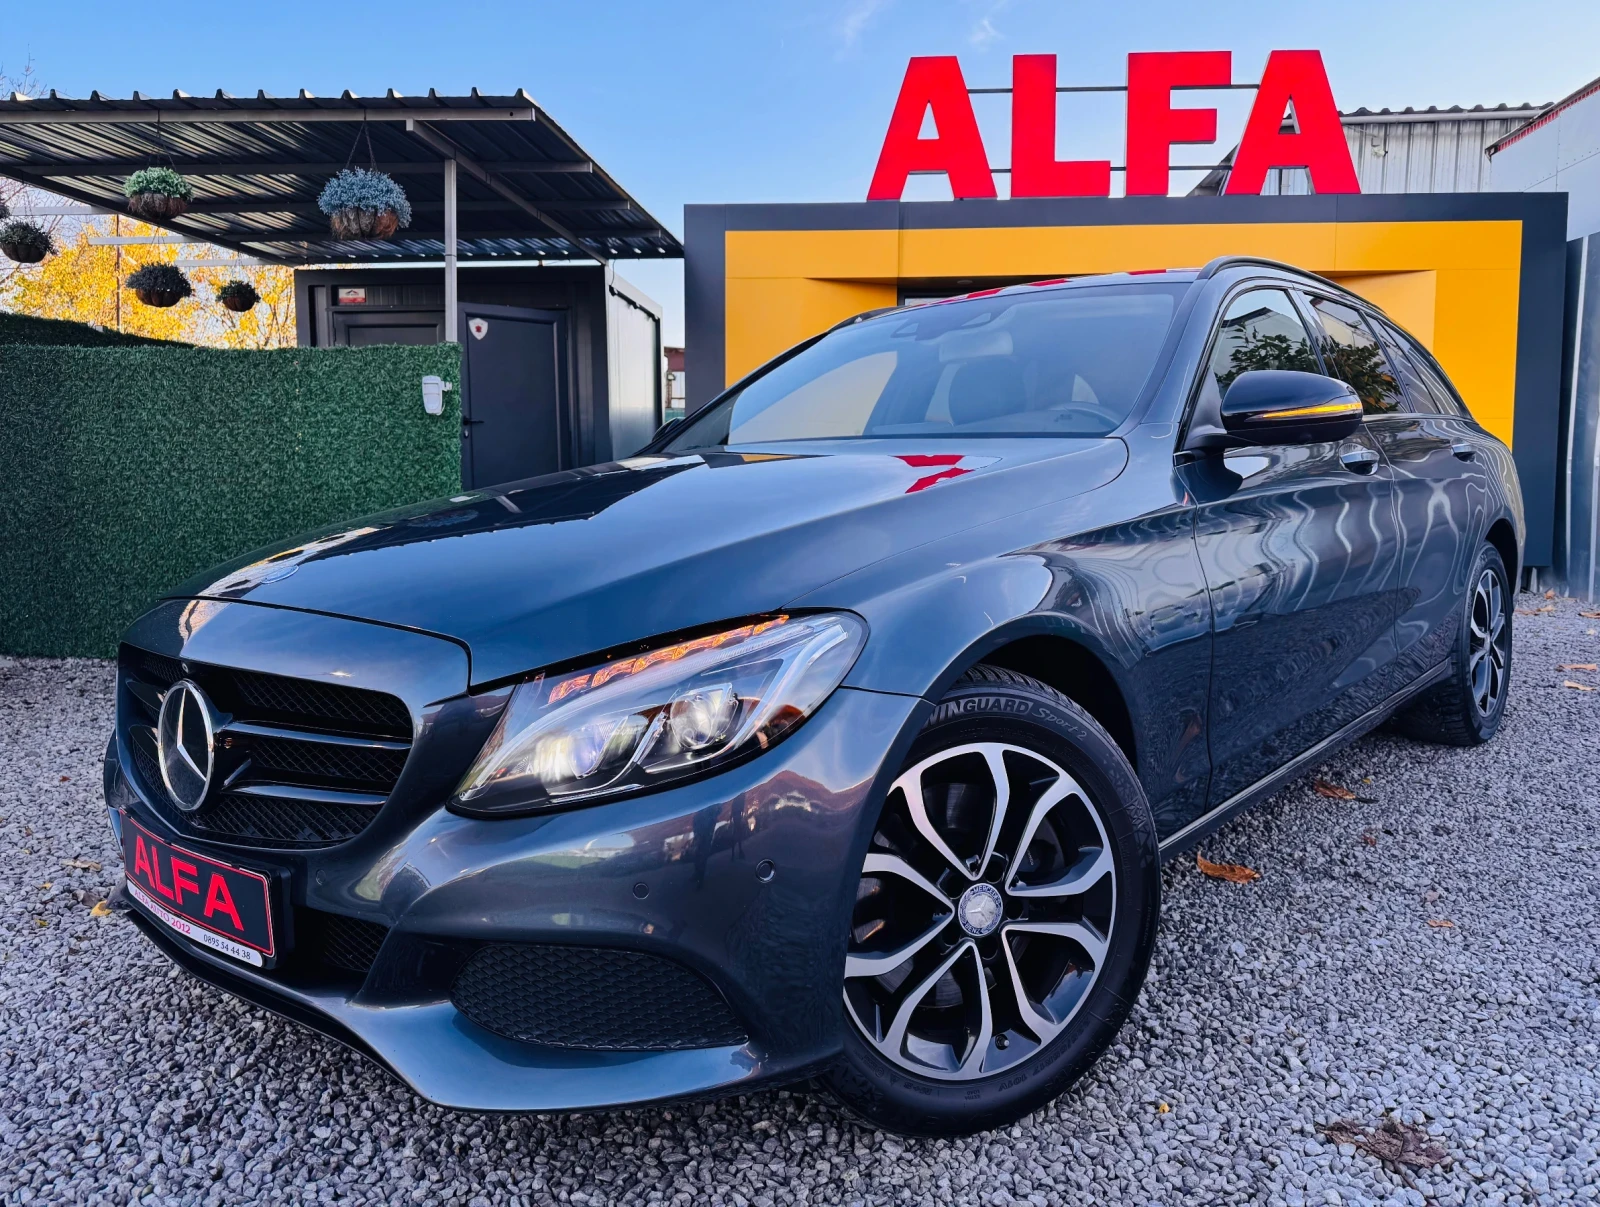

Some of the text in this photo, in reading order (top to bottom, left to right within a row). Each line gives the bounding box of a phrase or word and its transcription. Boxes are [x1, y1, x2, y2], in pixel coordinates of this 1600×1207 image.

[867, 50, 1361, 200] ALFA
[1032, 707, 1078, 733] Sport
[1076, 730, 1087, 741] 2
[134, 835, 244, 931] ALFA
[134, 890, 191, 934] ALFA AUTO 2012
[203, 934, 251, 960] 0895 54 44 38
